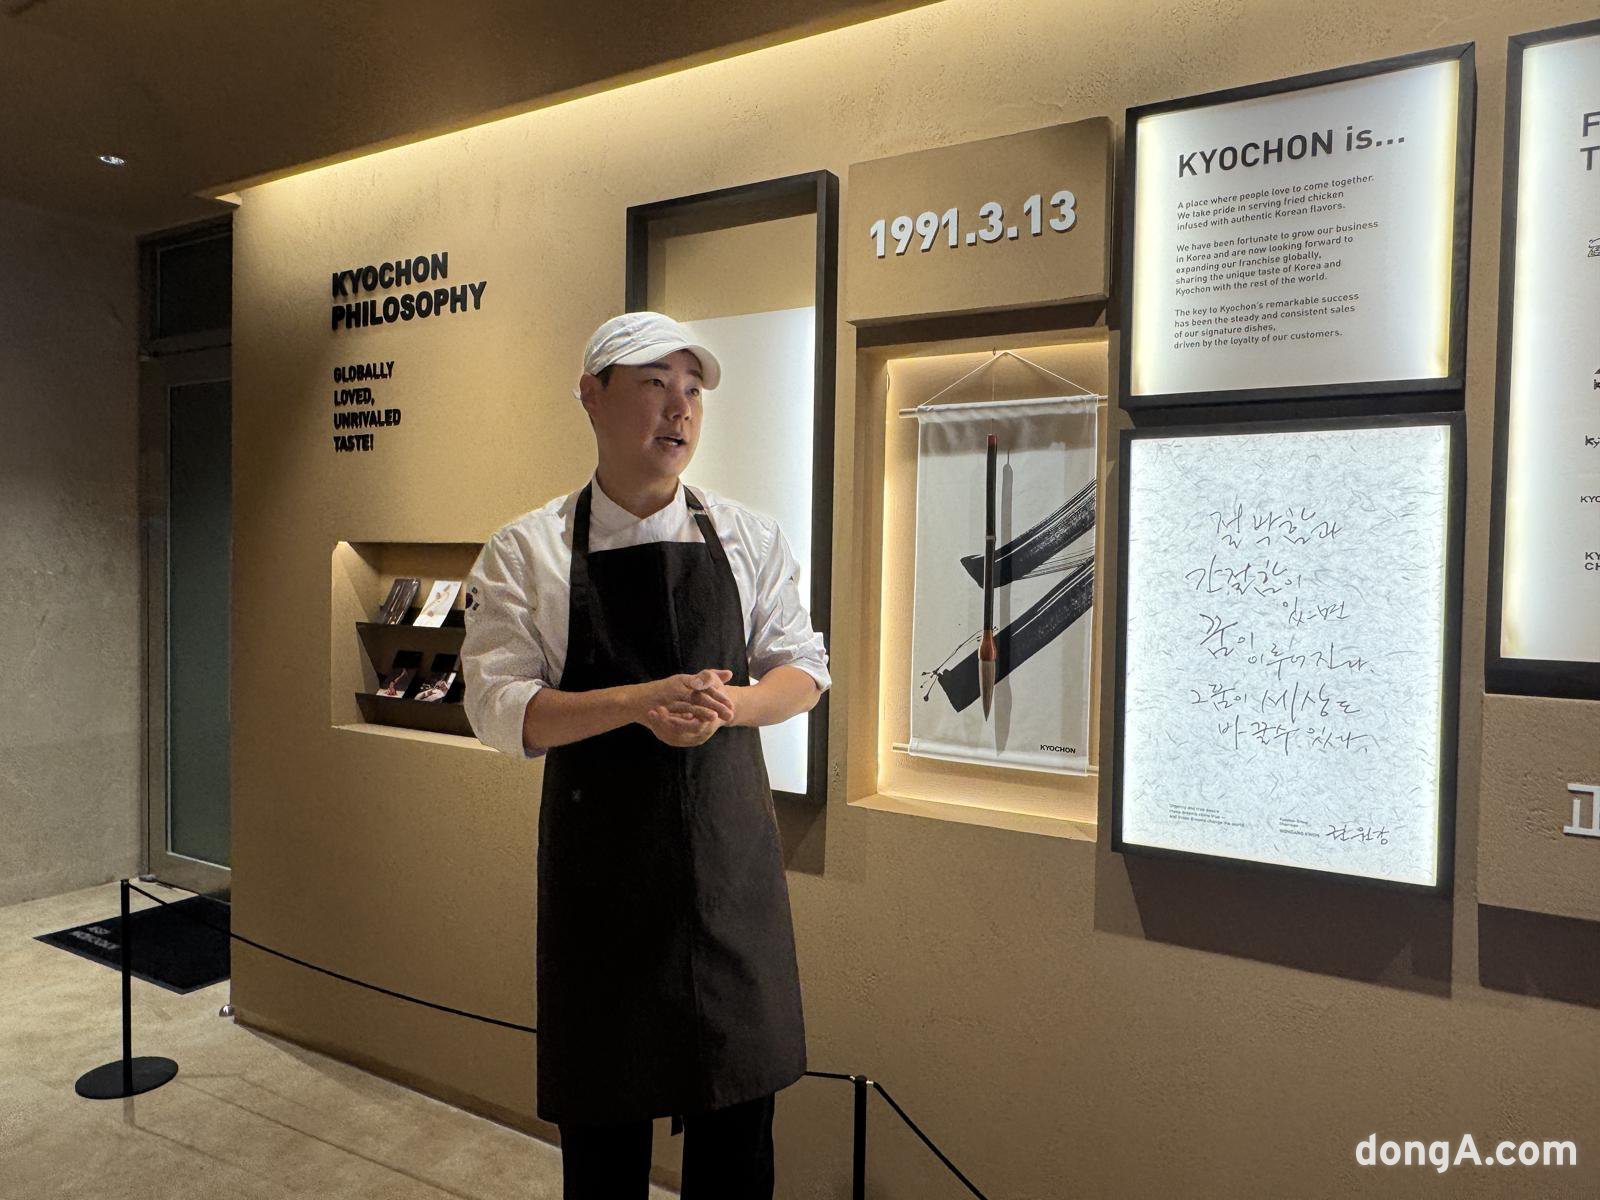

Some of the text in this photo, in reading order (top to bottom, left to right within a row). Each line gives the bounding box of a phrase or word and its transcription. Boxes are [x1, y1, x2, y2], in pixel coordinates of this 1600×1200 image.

[1178, 125, 1406, 179] KYOCHON is...
[1186, 200, 1208, 209] place
[1211, 196, 1237, 204] where
[1239, 189, 1269, 202] people
[1272, 186, 1289, 195] love
[1304, 182, 1328, 191] come
[1332, 175, 1374, 187] together.
[1193, 210, 1210, 218] take
[1213, 206, 1235, 216] pride
[1248, 200, 1281, 210] serving
[1284, 195, 1305, 205] fried
[1308, 191, 1344, 202] chicken
[870, 190, 1076, 258] 1991.3.13
[1177, 203, 1345, 230] infused with authentic Korean flavors.
[1237, 234, 1277, 244] fortunate
[1292, 230, 1314, 240] grow
[1318, 227, 1333, 235] our
[1336, 221, 1378, 232] business
[1214, 250, 1229, 258] and
[1270, 242, 1302, 251] looking
[1305, 237, 1341, 248] forward
[332, 252, 449, 299] KYOCHON
[1176, 263, 1219, 274] expanding
[1239, 256, 1280, 266] franchise
[1176, 276, 1207, 284] sharing
[1258, 268, 1280, 276] taste
[1283, 265, 1291, 273] of
[1295, 263, 1321, 271] Korea
[1324, 260, 1341, 268] and
[1176, 286, 1210, 296] Kyochon
[1213, 283, 1231, 291] with
[1251, 279, 1267, 287] rest
[1298, 273, 1327, 282] world.
[332, 281, 487, 331] PHILOSOPHY
[1220, 302, 1263, 313] Kyochon's
[1266, 297, 1319, 308] remarkable
[1322, 294, 1359, 303] success
[1231, 314, 1259, 322] steady
[1262, 312, 1278, 320] and
[1281, 307, 1327, 318] consistent
[1330, 305, 1355, 313] sales
[1201, 326, 1242, 337] signature
[1245, 324, 1275, 333] dishes,
[1203, 340, 1212, 348] by
[1231, 336, 1259, 345] loyalty
[1273, 334, 1288, 342] our
[1291, 330, 1343, 340] customers.
[333, 361, 394, 384] GLOBALLY
[333, 387, 375, 407] LOVED,
[333, 408, 401, 431] UNRIVALED
[333, 434, 374, 453] TASTE!
[1185, 554, 1301, 597] 간절함이
[1040, 744, 1076, 754] KYOCHON
